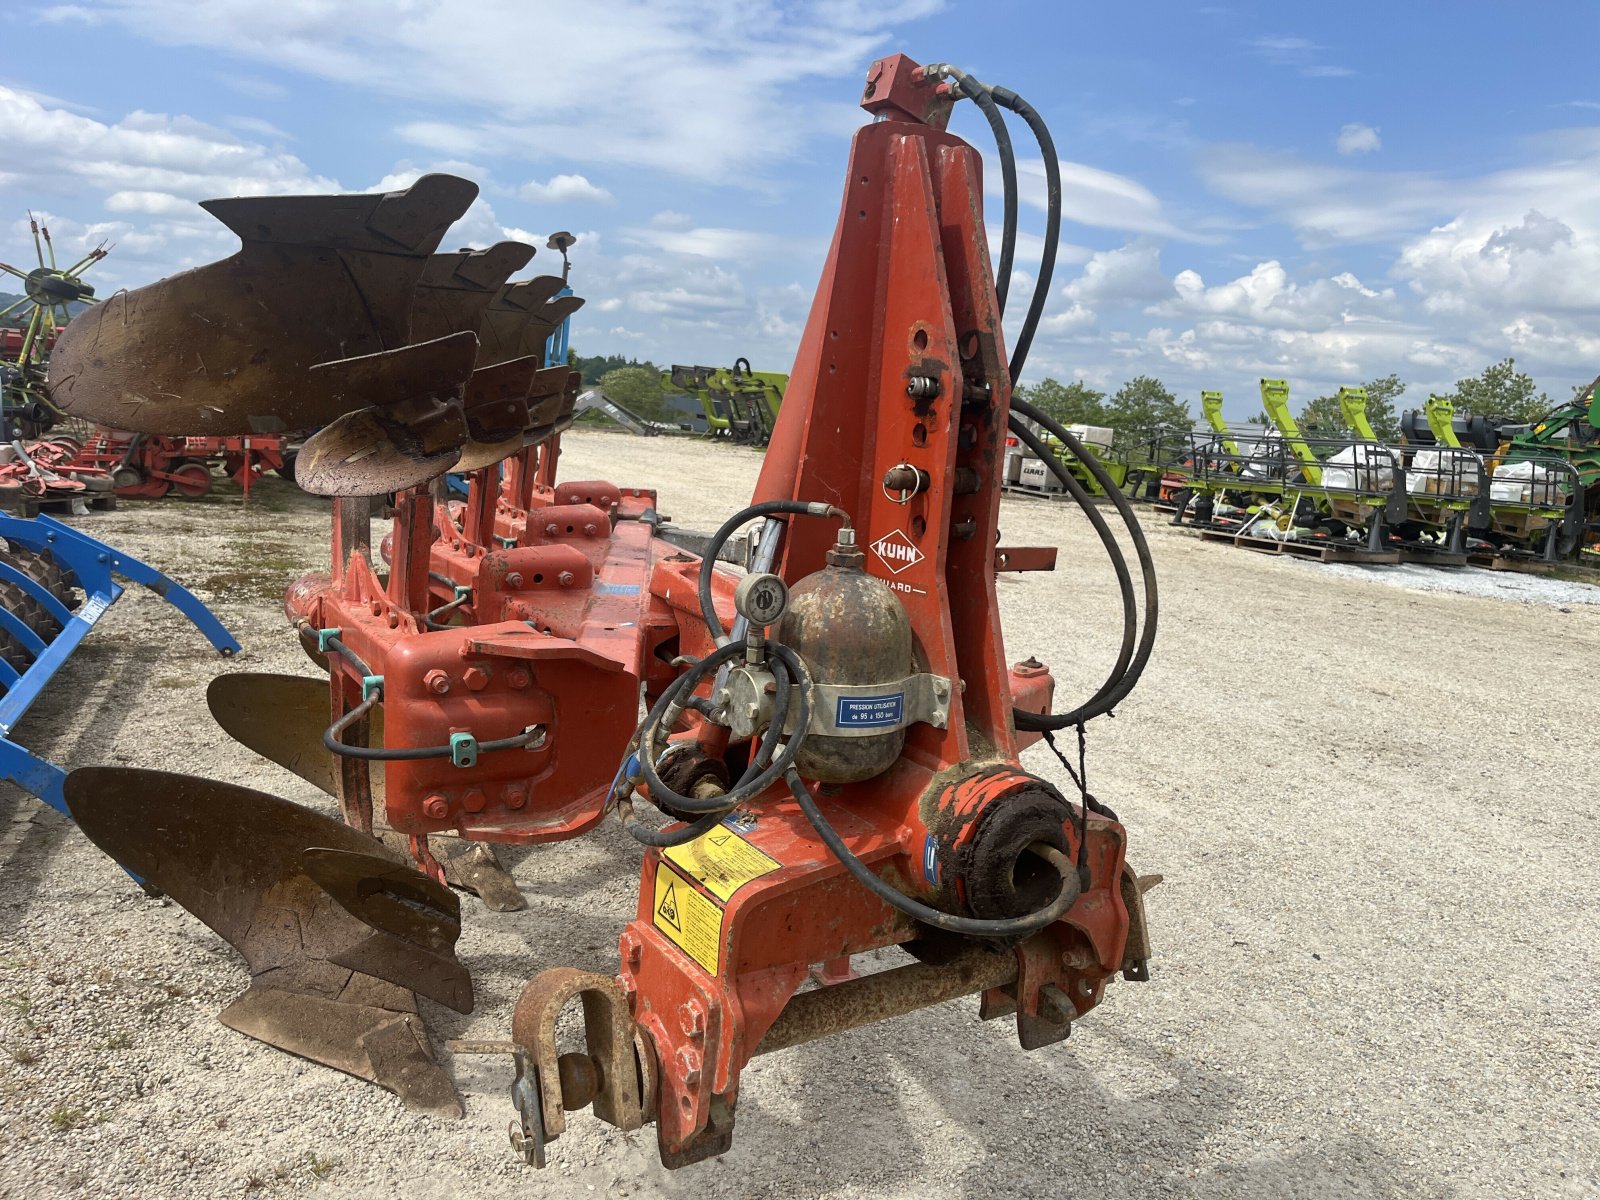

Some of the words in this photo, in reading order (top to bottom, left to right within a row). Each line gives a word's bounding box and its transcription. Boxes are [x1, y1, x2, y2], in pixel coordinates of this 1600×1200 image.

[1023, 467, 1045, 476] CLAAS
[877, 541, 916, 563] KUHN
[860, 712, 868, 720] 95
